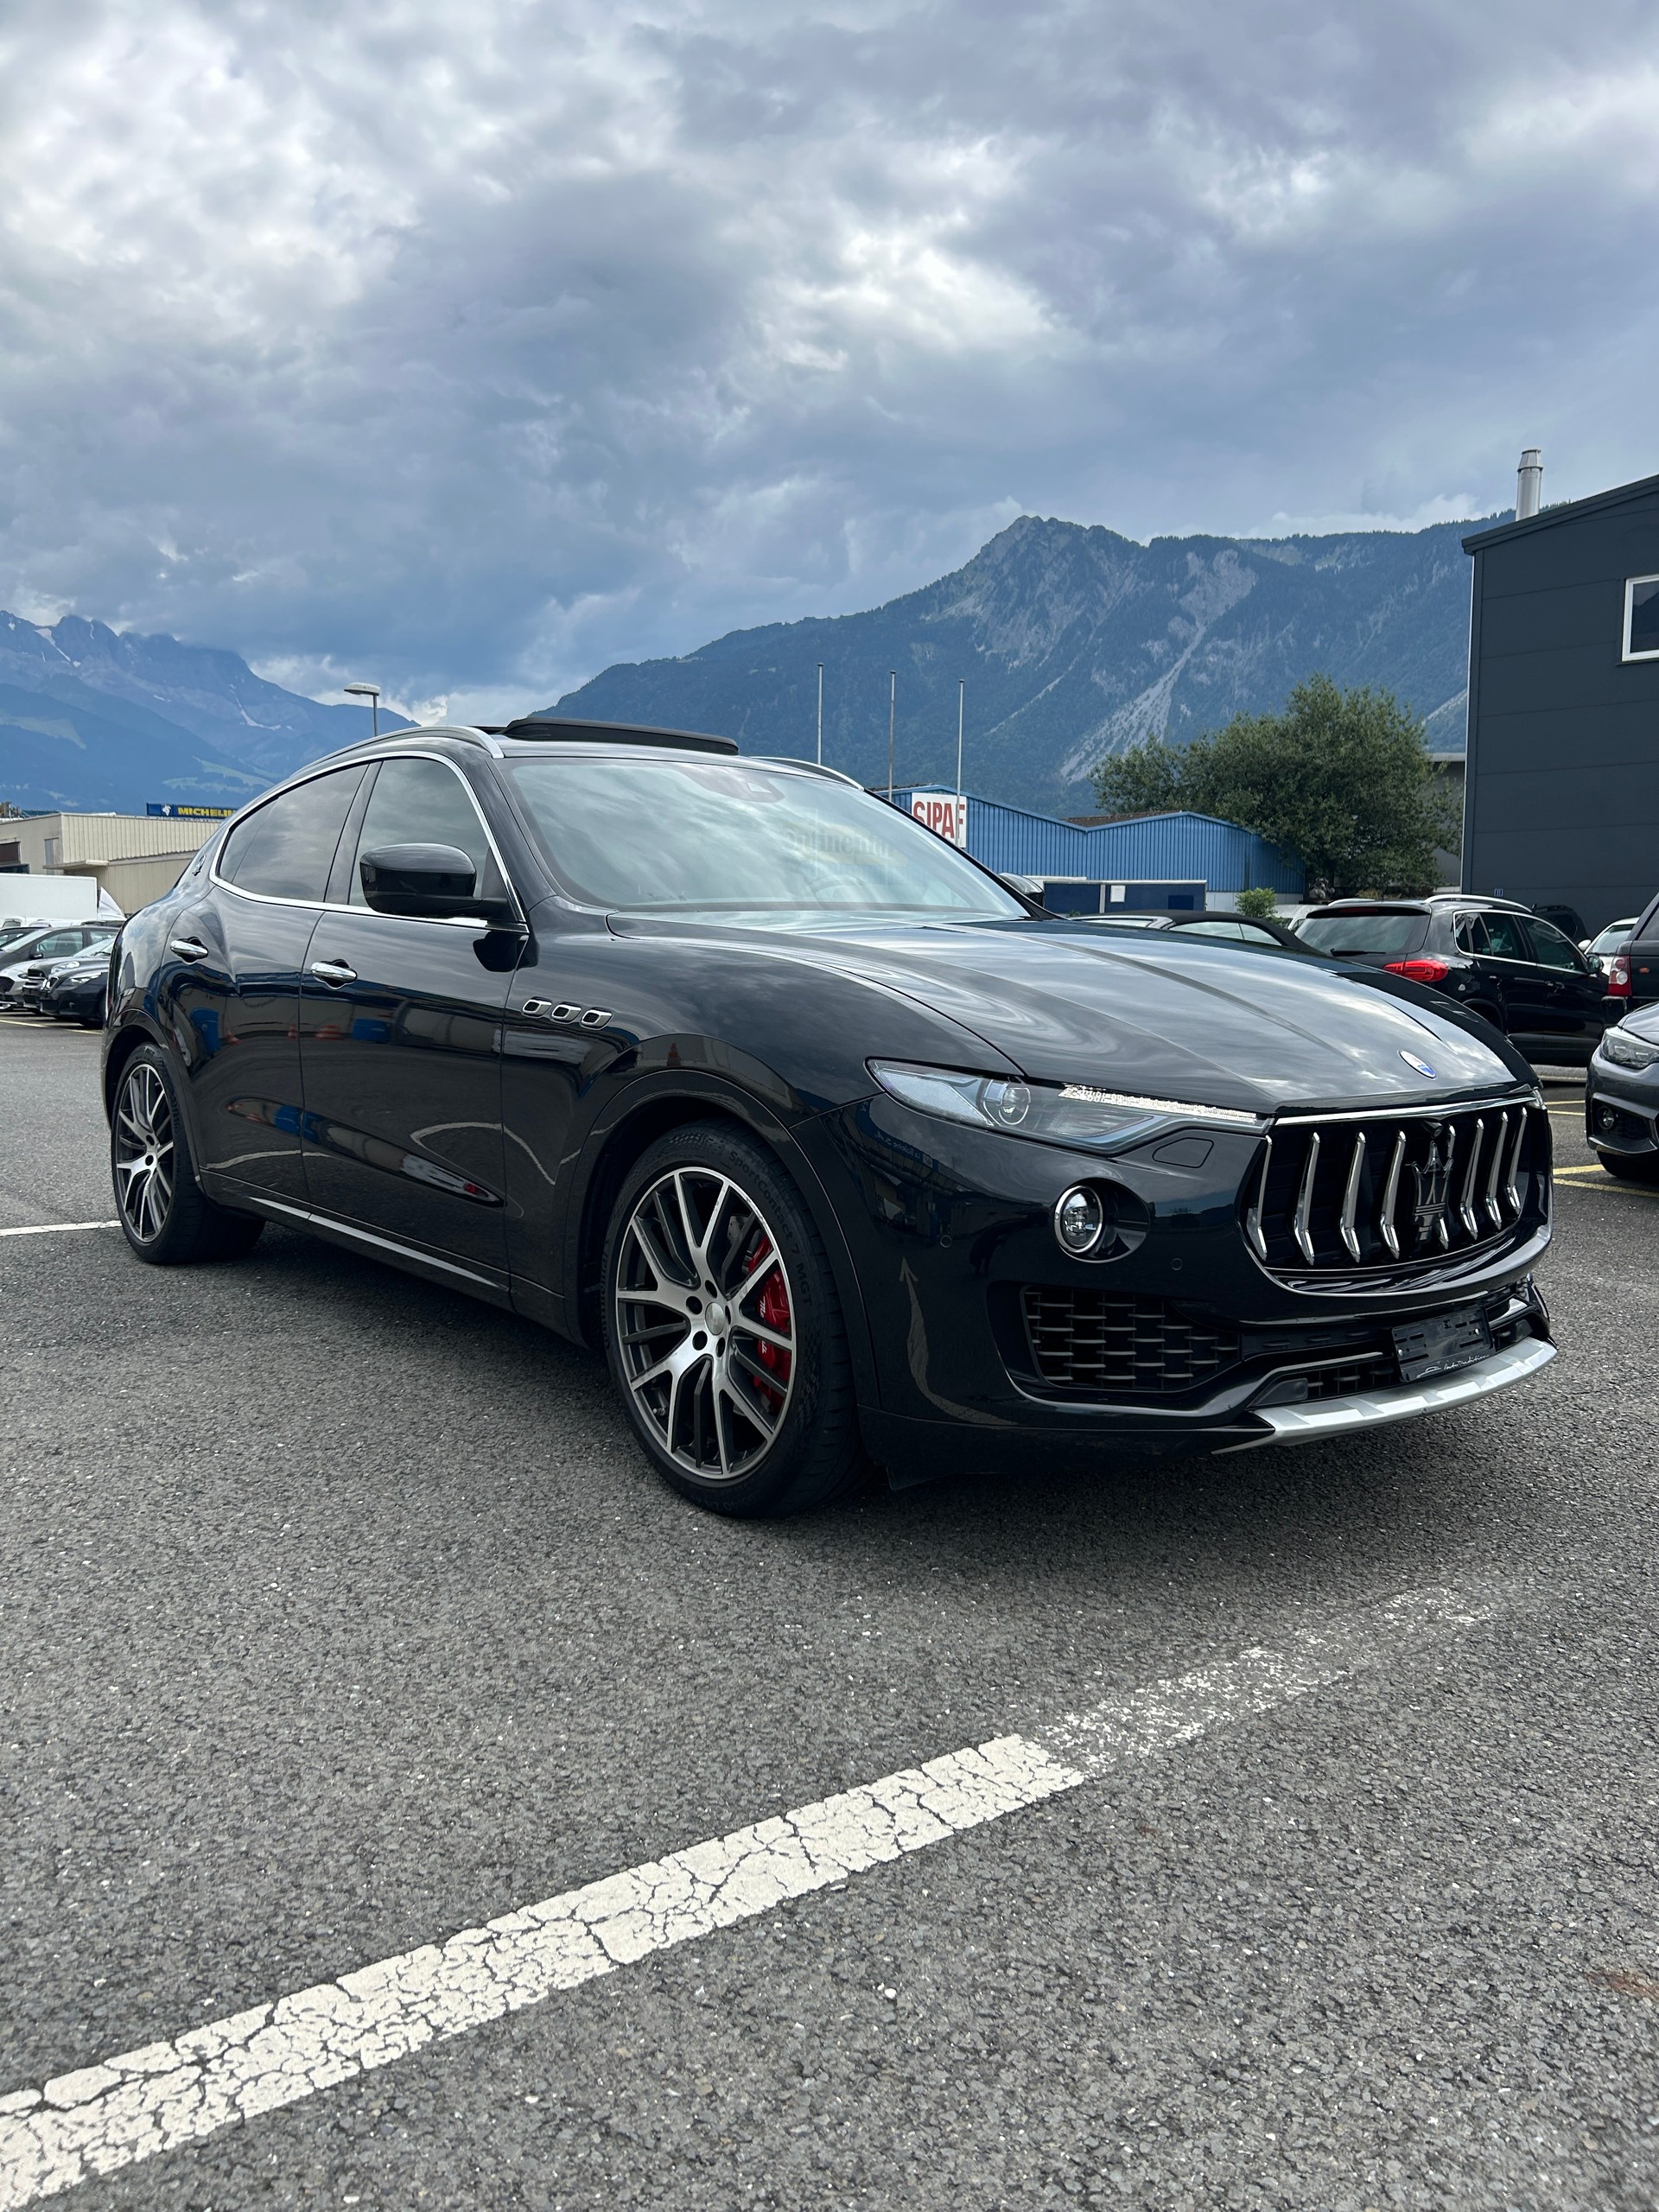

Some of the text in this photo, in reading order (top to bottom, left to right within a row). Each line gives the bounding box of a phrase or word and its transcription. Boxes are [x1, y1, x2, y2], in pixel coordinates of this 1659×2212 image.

[728, 1151, 812, 1306] SportContact 7 MGT
